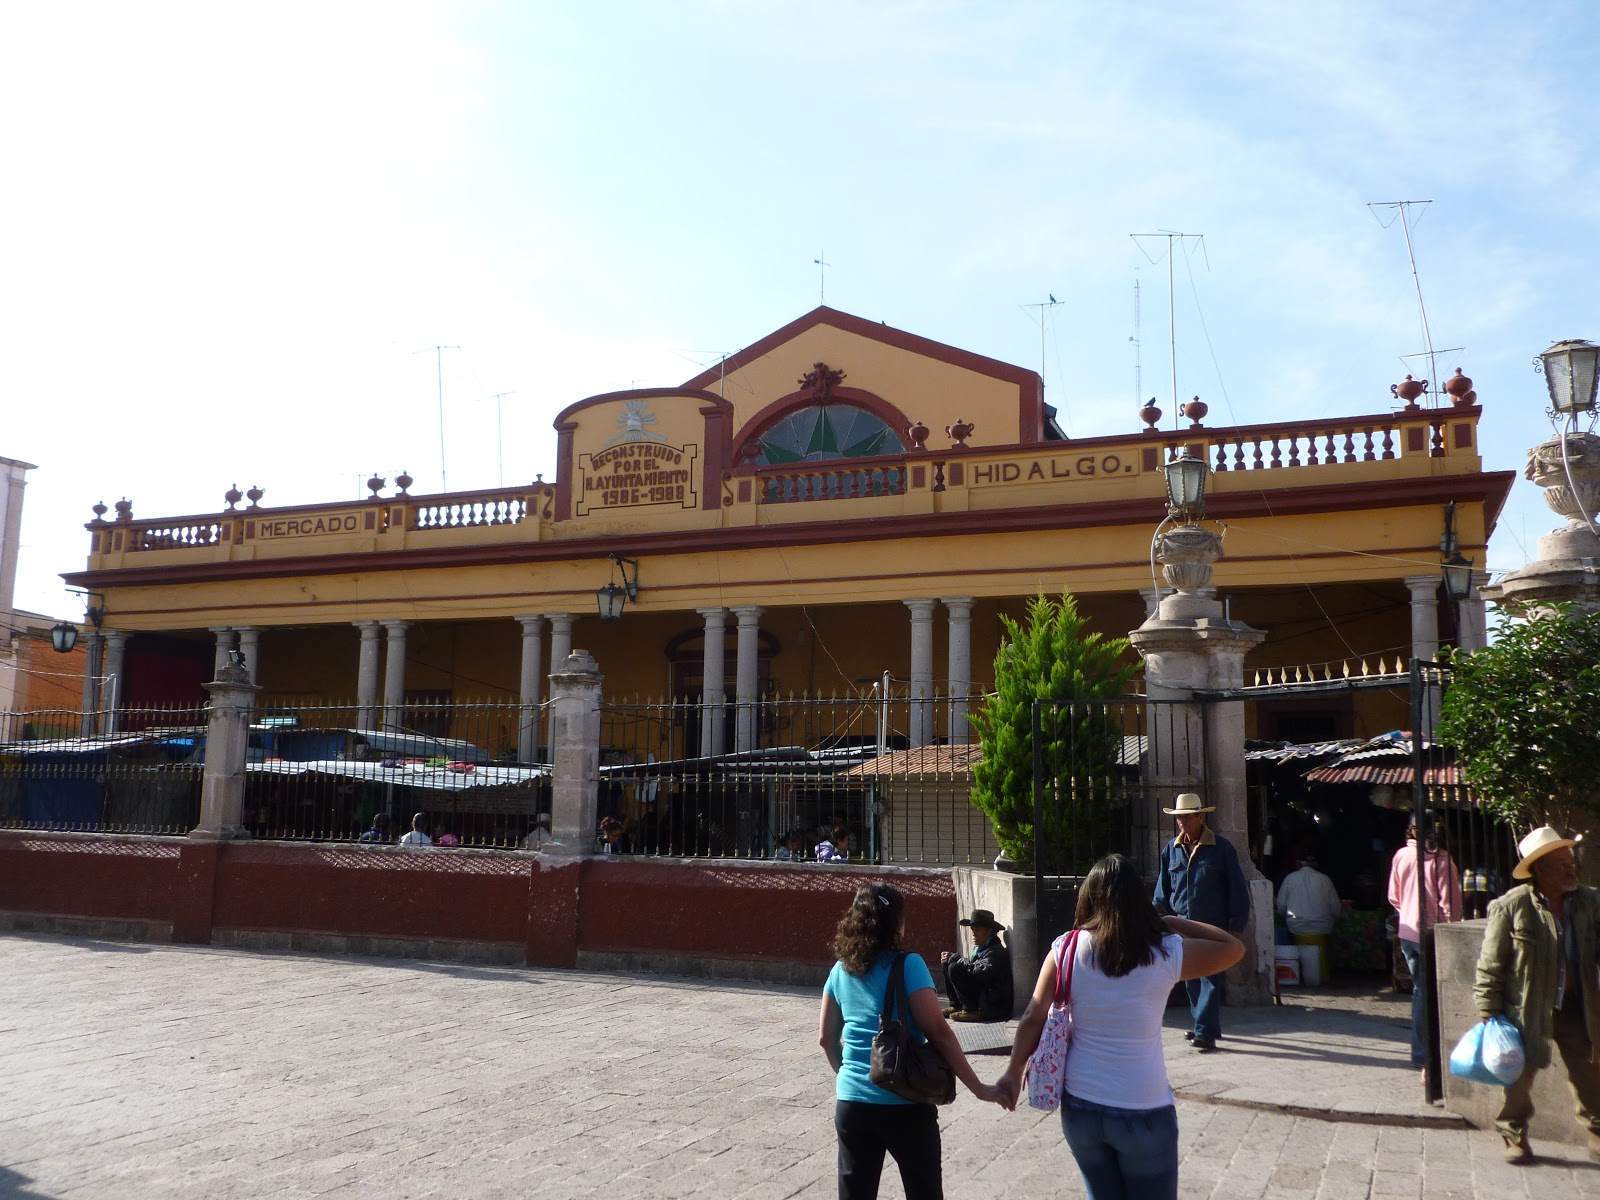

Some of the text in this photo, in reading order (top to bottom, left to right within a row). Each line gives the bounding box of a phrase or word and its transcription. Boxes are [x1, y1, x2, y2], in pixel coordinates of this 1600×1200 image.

[592, 444, 681, 471] RECONSTRUIDO
[613, 458, 660, 474] POR EL
[260, 515, 357, 537] MERCADO
